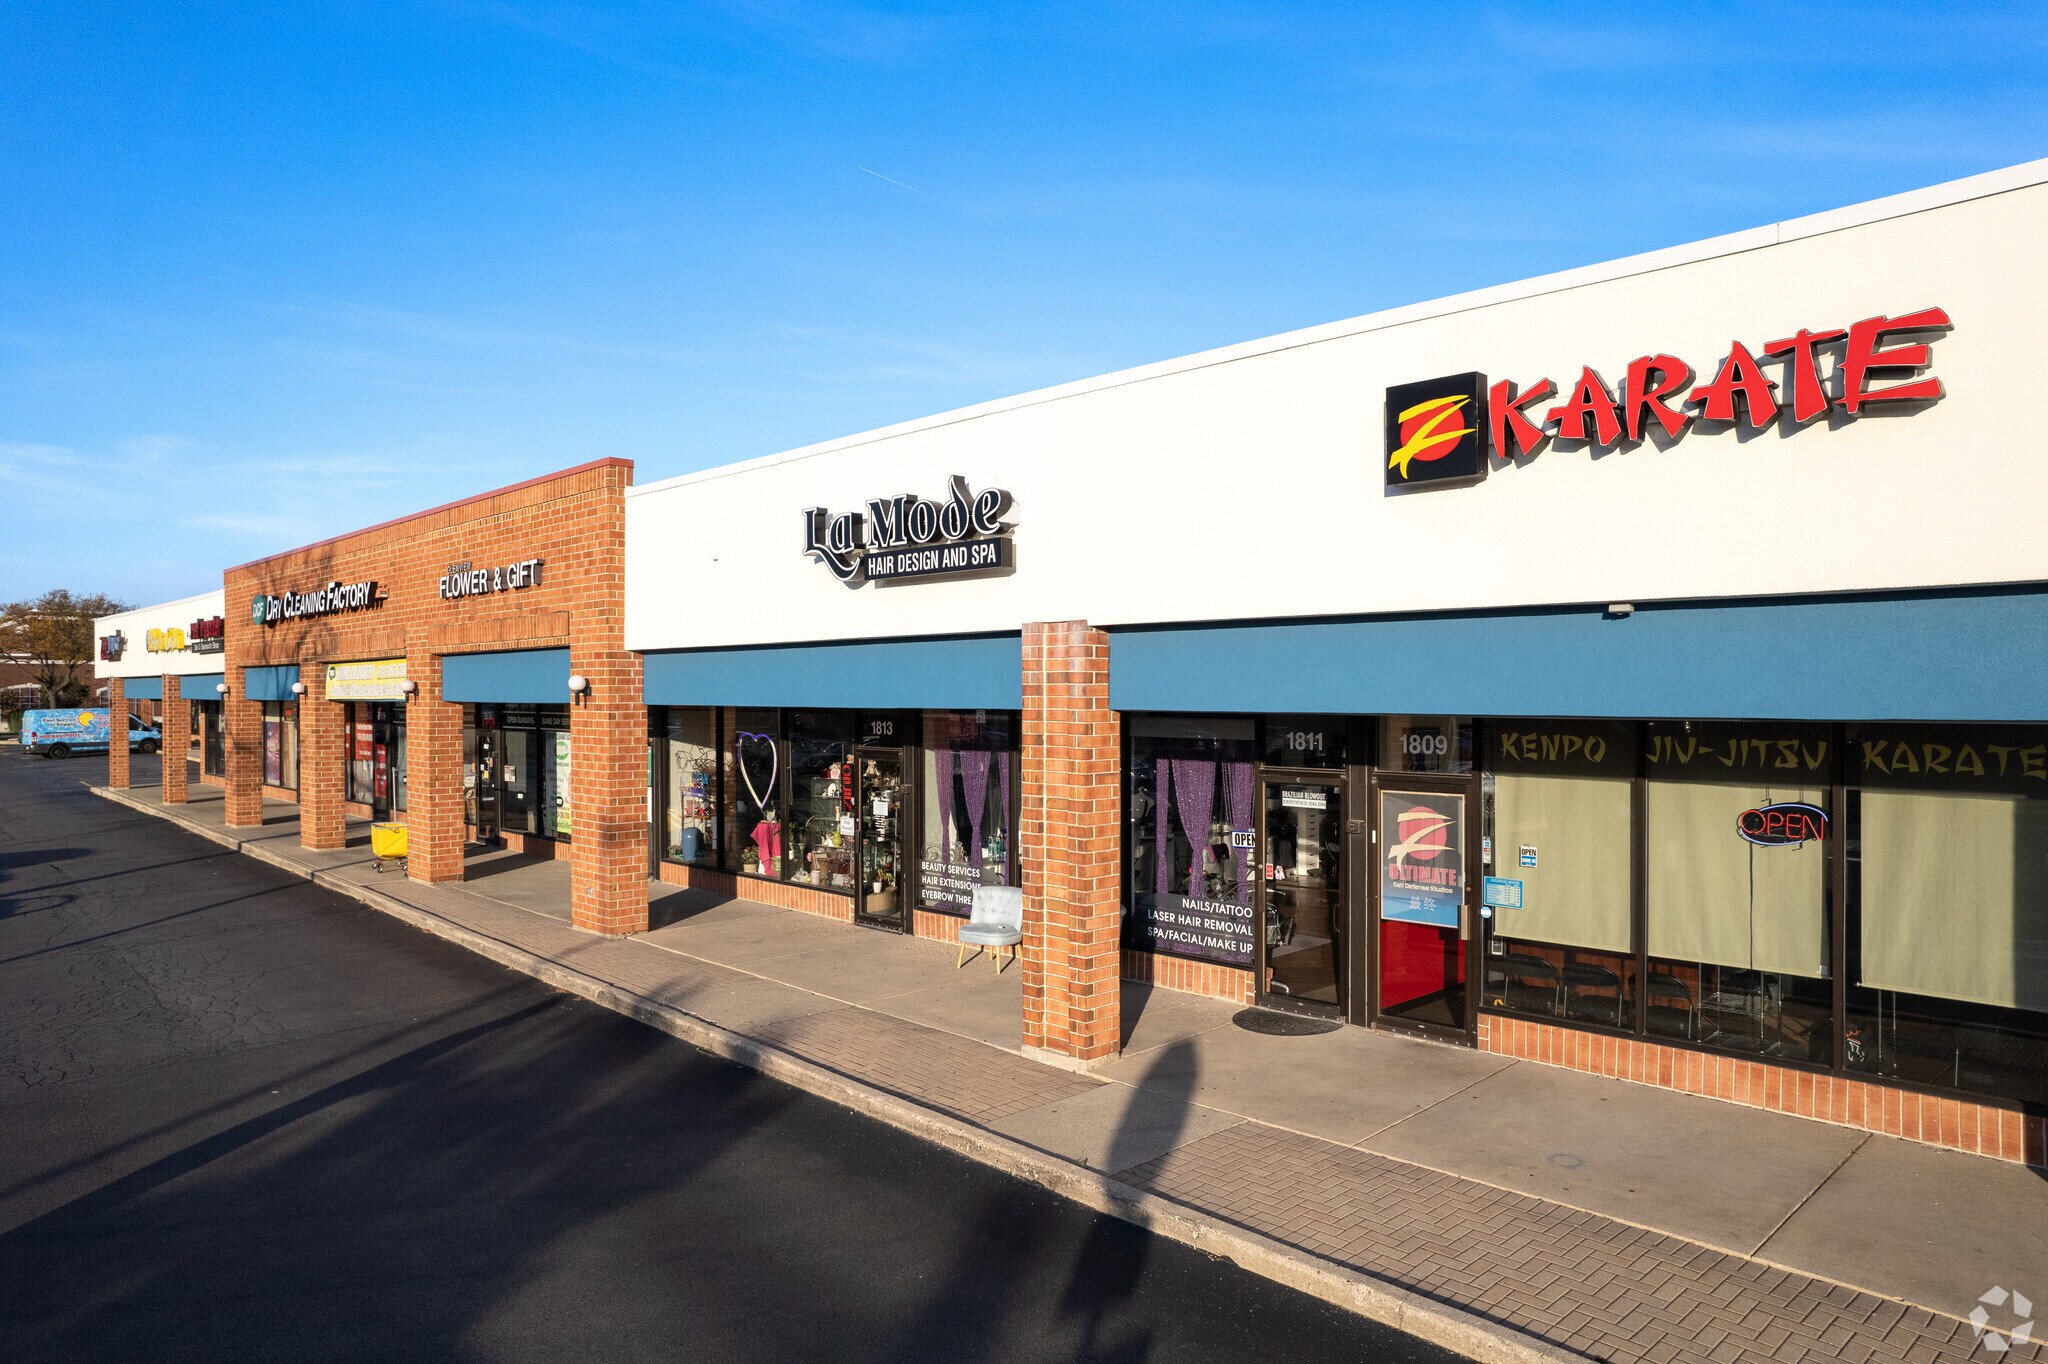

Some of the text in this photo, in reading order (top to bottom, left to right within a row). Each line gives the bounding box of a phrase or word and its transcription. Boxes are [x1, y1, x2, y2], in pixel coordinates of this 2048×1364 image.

[1488, 307, 1954, 460] KARATE
[801, 475, 1004, 582] La Mode
[868, 543, 997, 576] HAIR DESIGN AND SPA
[440, 558, 538, 599] FLOWER & GIFT
[266, 595, 282, 620] DRY
[283, 591, 326, 618] CLEANING
[326, 581, 371, 610] FACTORY
[507, 716, 534, 725] OPEN SUNDAYS
[871, 721, 893, 735] 1813
[1286, 731, 1323, 751] 1811
[1399, 734, 1448, 755] 1809
[1500, 732, 1606, 763] KENPO
[1862, 739, 2048, 781] KARATE
[1282, 791, 1326, 800] BRAZILIAN BLOWOUT
[1739, 809, 1825, 841] OPEN
[1521, 848, 1536, 856] OPEN
[921, 861, 980, 878] BEAUTY SERVICES
[1388, 863, 1457, 886] ULTIMATE
[921, 875, 982, 891] HAIR EXTENSIONS
[1404, 883, 1430, 891] Defense
[1430, 885, 1453, 894] Studios
[921, 889, 973, 905] EYEBROW THRE
[1182, 898, 1253, 918] NAILS/TATTOO
[1147, 909, 1253, 936] LASER HAIR REMOVAL
[1147, 926, 1253, 954] SPA/FACIAL/MAKE UP
